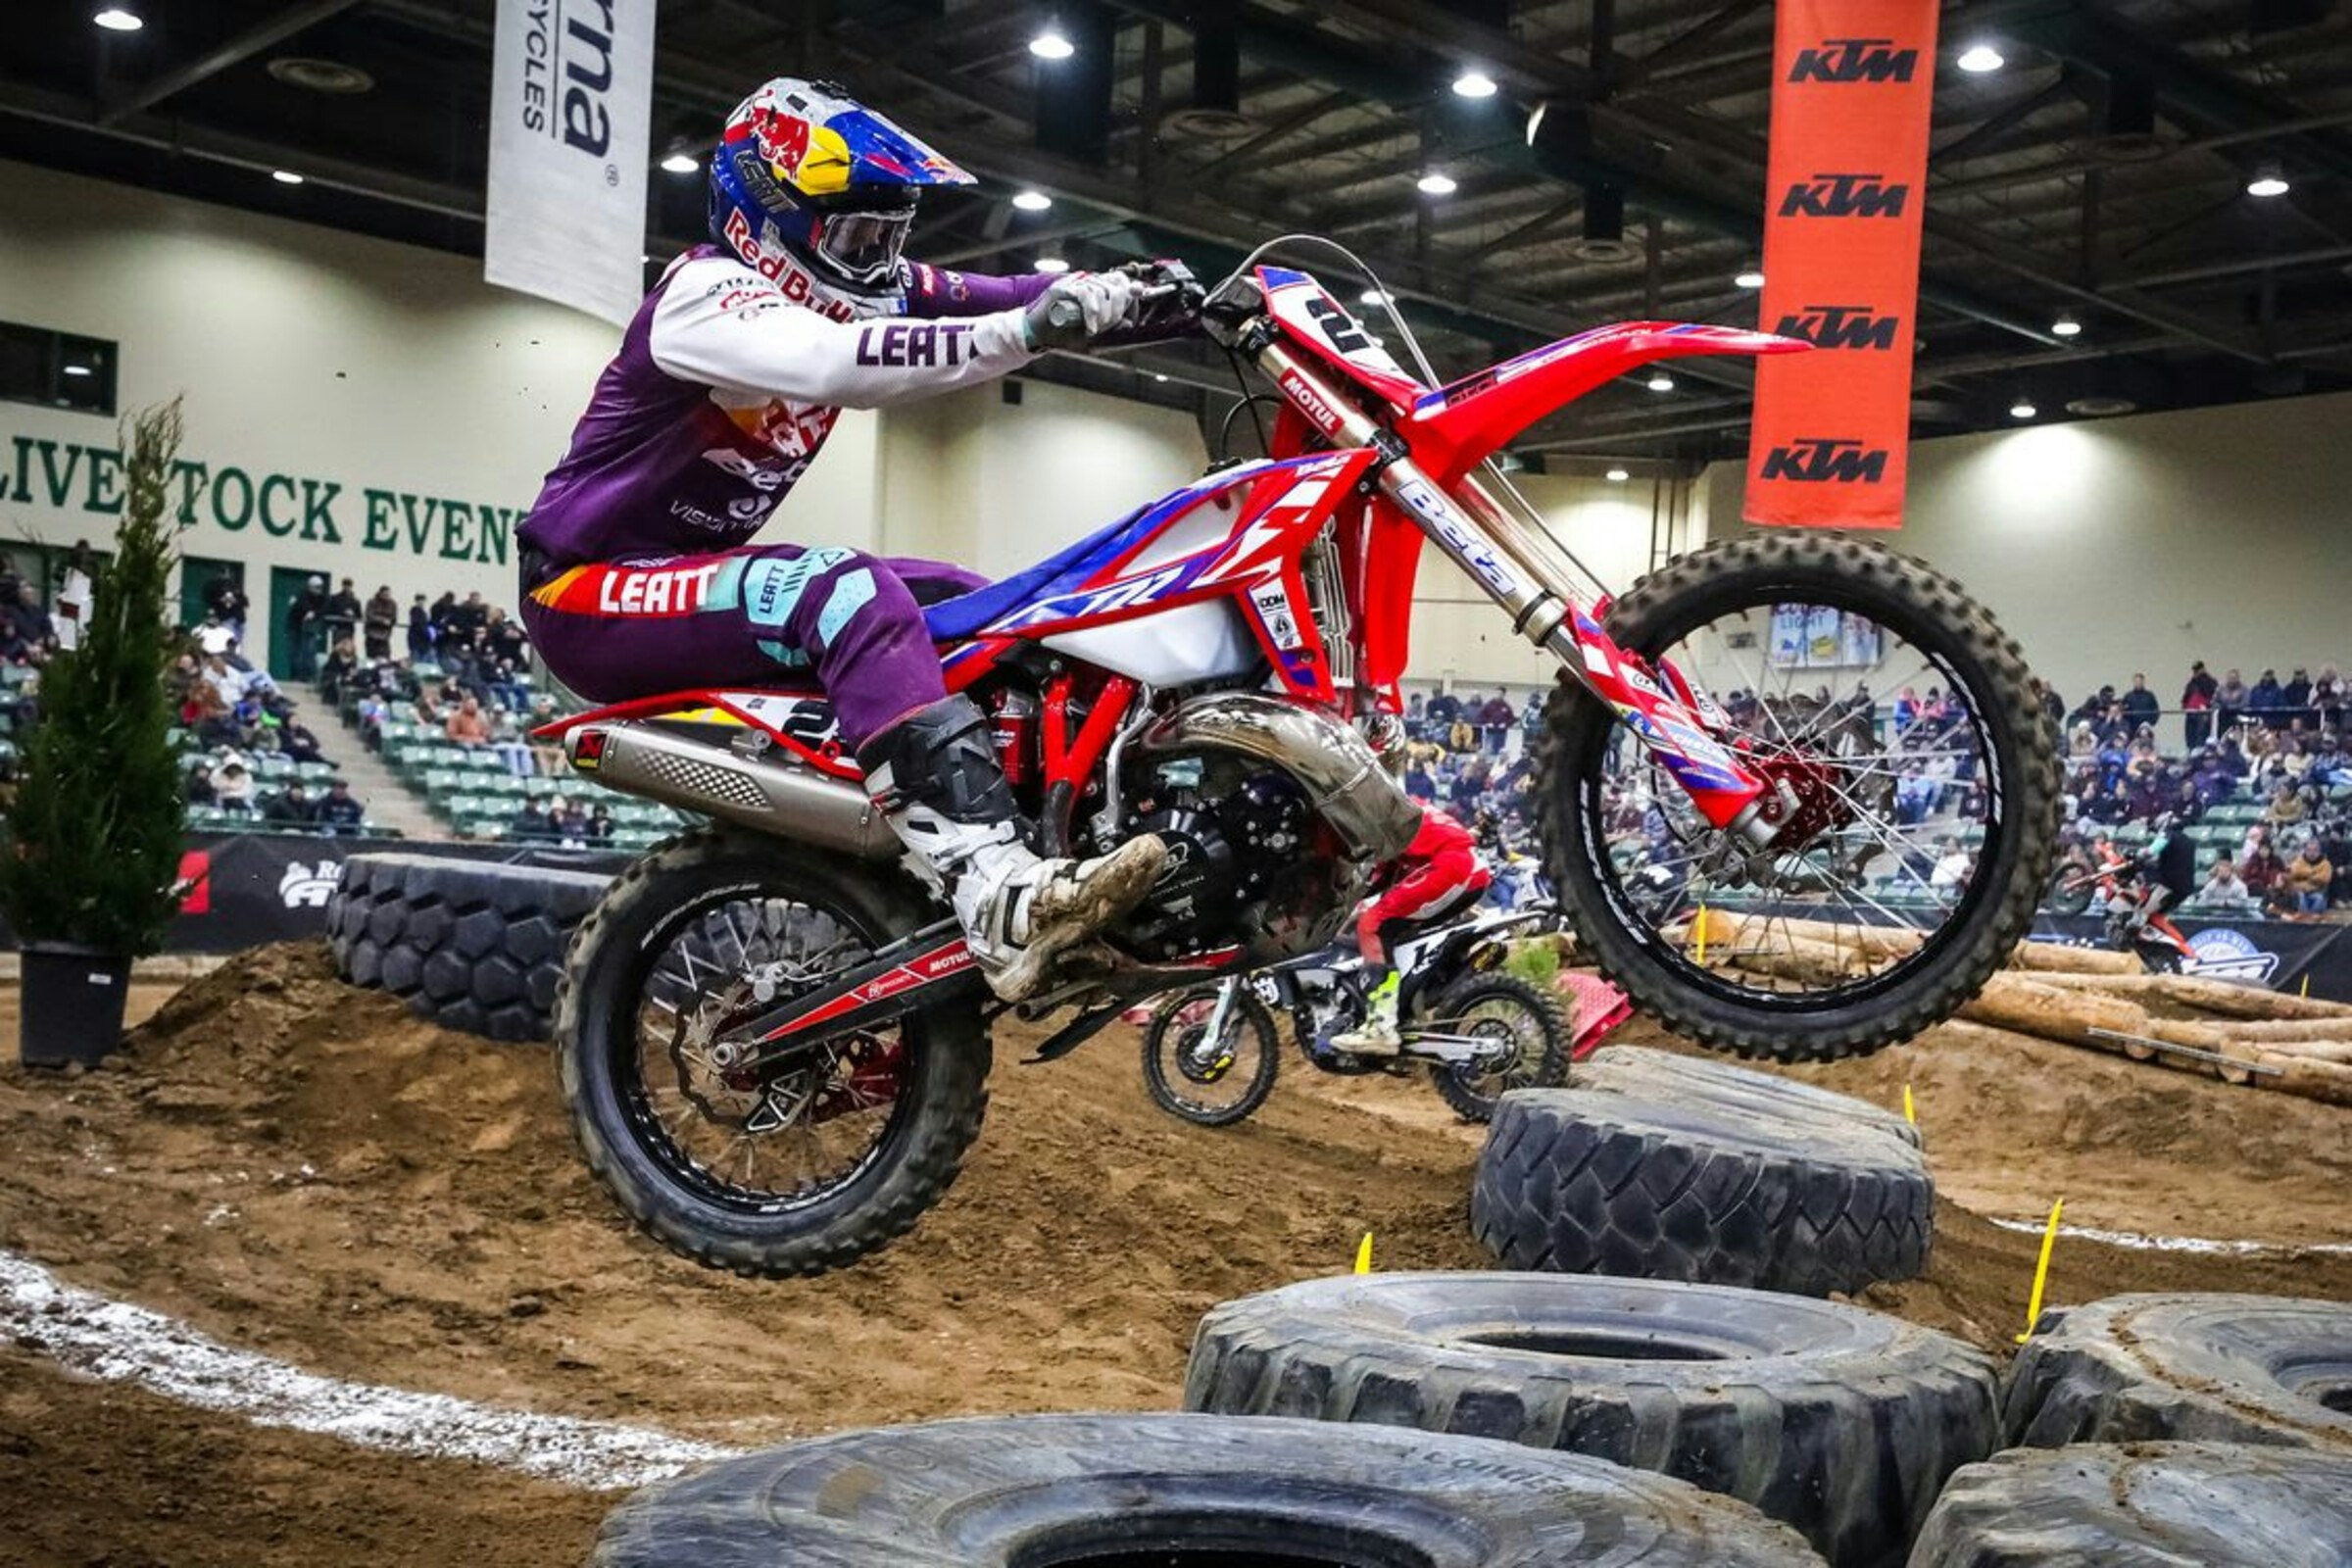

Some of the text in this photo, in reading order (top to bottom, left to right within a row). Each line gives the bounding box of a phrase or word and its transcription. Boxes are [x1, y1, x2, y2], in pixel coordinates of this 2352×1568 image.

[522, 0, 549, 133] YCLES
[1788, 39, 1920, 83] KTM
[1778, 174, 1909, 218] KTM
[1305, 297, 1372, 354] 2
[1772, 306, 1899, 352] KTM
[1284, 375, 1339, 430] MOTUL
[1760, 438, 1888, 483] KTM
[0, 435, 342, 546] IVETOCK
[1398, 480, 1516, 597] Beta
[600, 563, 718, 613] LEATT
[759, 564, 785, 614] LEATT
